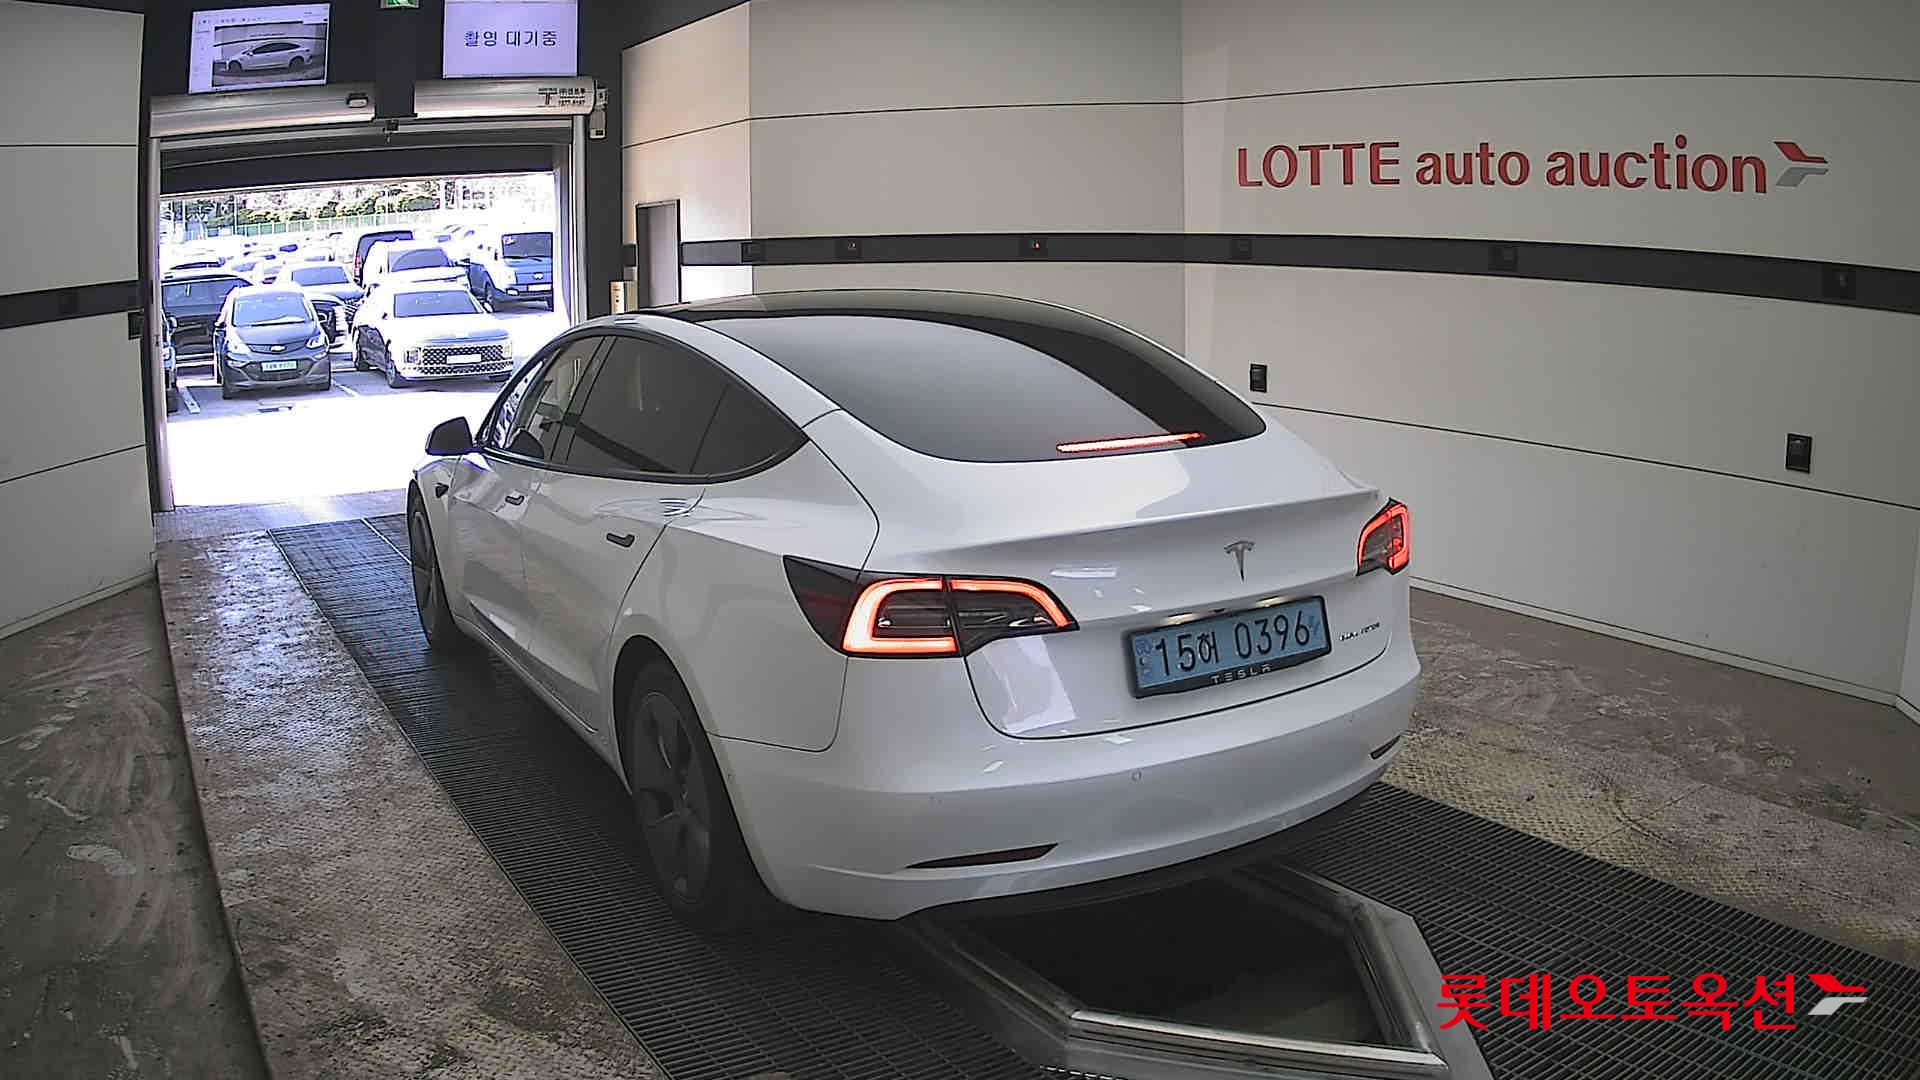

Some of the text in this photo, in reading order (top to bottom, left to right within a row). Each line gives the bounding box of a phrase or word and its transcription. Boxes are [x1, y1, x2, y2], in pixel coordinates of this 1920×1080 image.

[464, 30, 558, 47] 촬영 대기중
[1238, 134, 1768, 194] LOTTE auto auction
[1155, 610, 1310, 677] 15허 0396
[1211, 664, 1272, 684] TESLA
